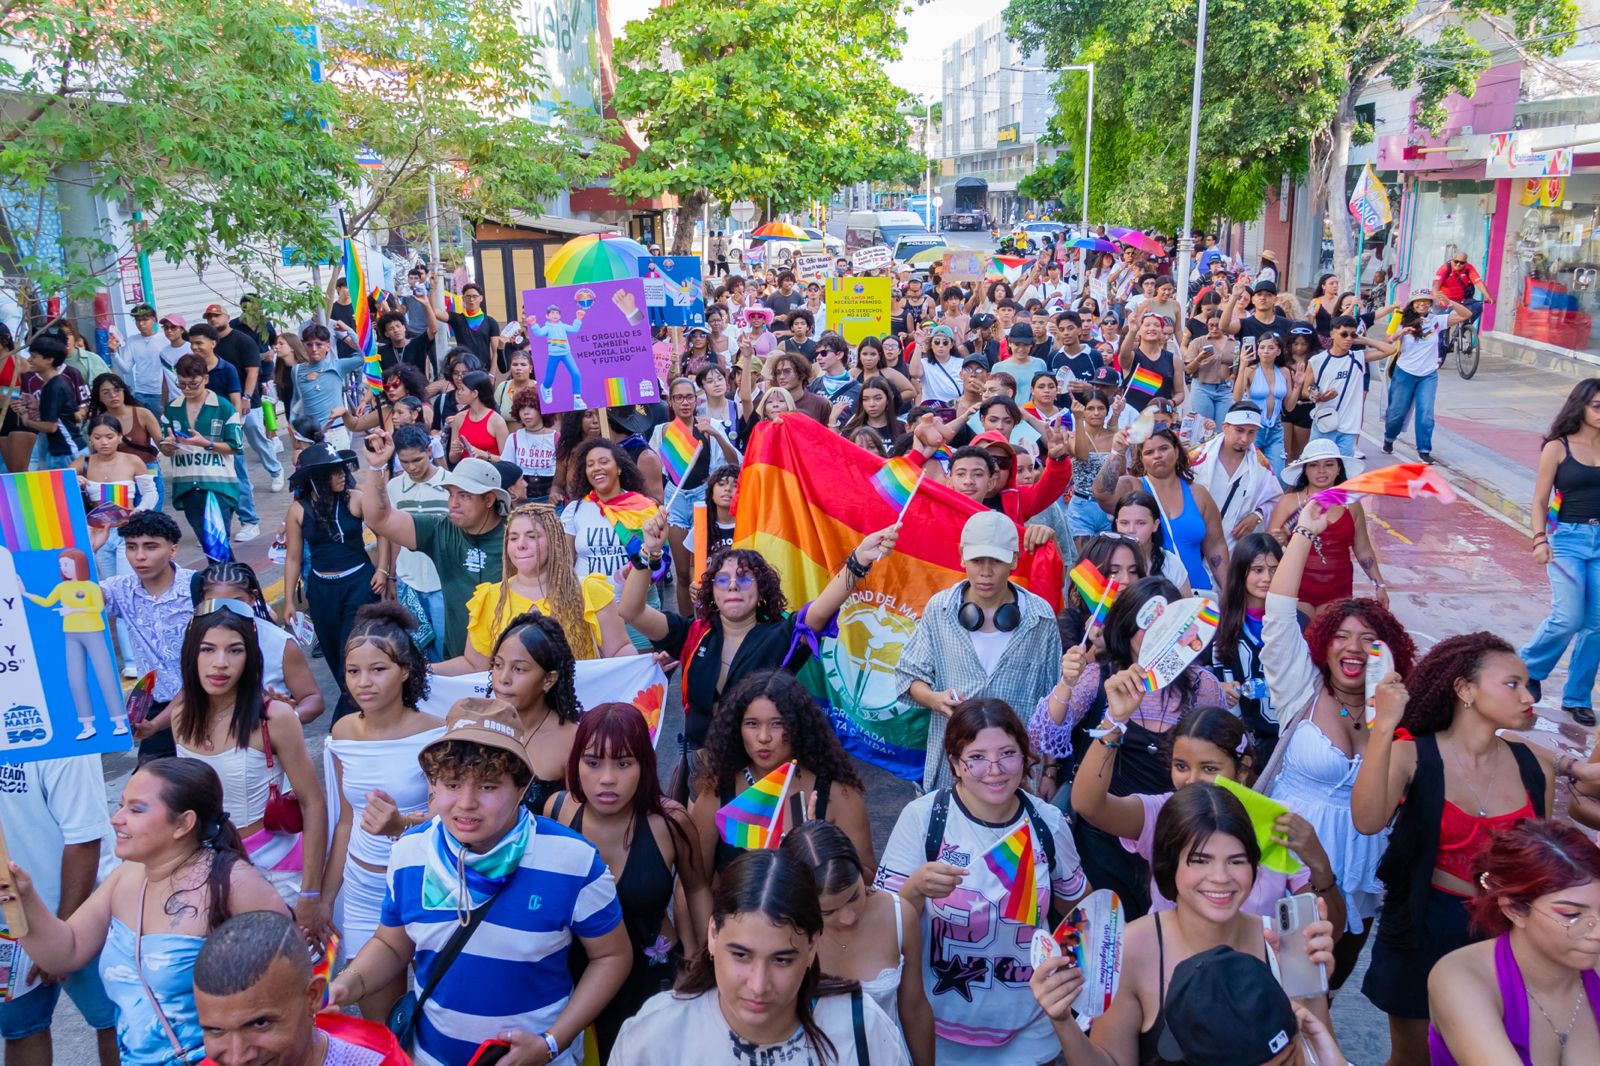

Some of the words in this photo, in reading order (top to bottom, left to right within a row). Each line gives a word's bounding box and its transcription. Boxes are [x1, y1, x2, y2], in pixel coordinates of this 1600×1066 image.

[591, 331, 631, 341] ORGULLO
[632, 329, 642, 337] ES
[576, 349, 618, 359] MEMORIA,
[620, 345, 647, 354] LUCHA
[592, 358, 597, 366] Y
[529, 448, 553, 458] DRAM
[520, 458, 550, 468] PLEASE
[587, 527, 623, 547] VIV
[590, 547, 597, 556] Y
[599, 546, 623, 556] DEJA
[3, 597, 15, 610] Y
[875, 592, 897, 609] DEL
[4, 644, 16, 657] Y
[3, 709, 41, 721] SANTA
[4, 716, 44, 728] MARTA
[7, 728, 47, 744] 500
[1105, 967, 1113, 994] PARTE
